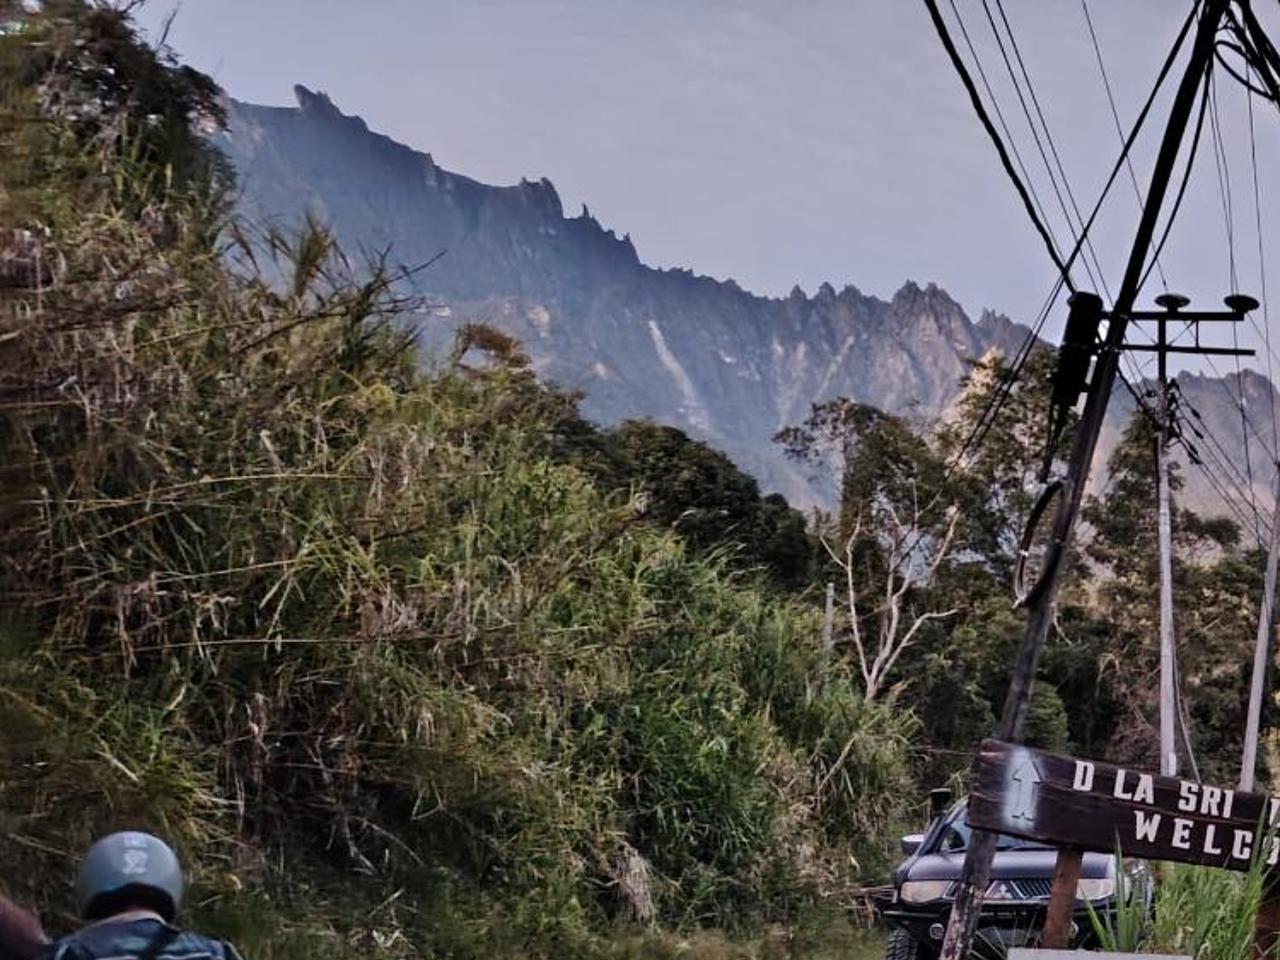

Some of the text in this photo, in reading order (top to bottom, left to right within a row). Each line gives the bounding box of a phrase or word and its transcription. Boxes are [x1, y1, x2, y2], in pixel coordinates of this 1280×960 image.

[1073, 760, 1095, 791] D
[1114, 769, 1155, 804] LA
[1178, 780, 1235, 818] SRI
